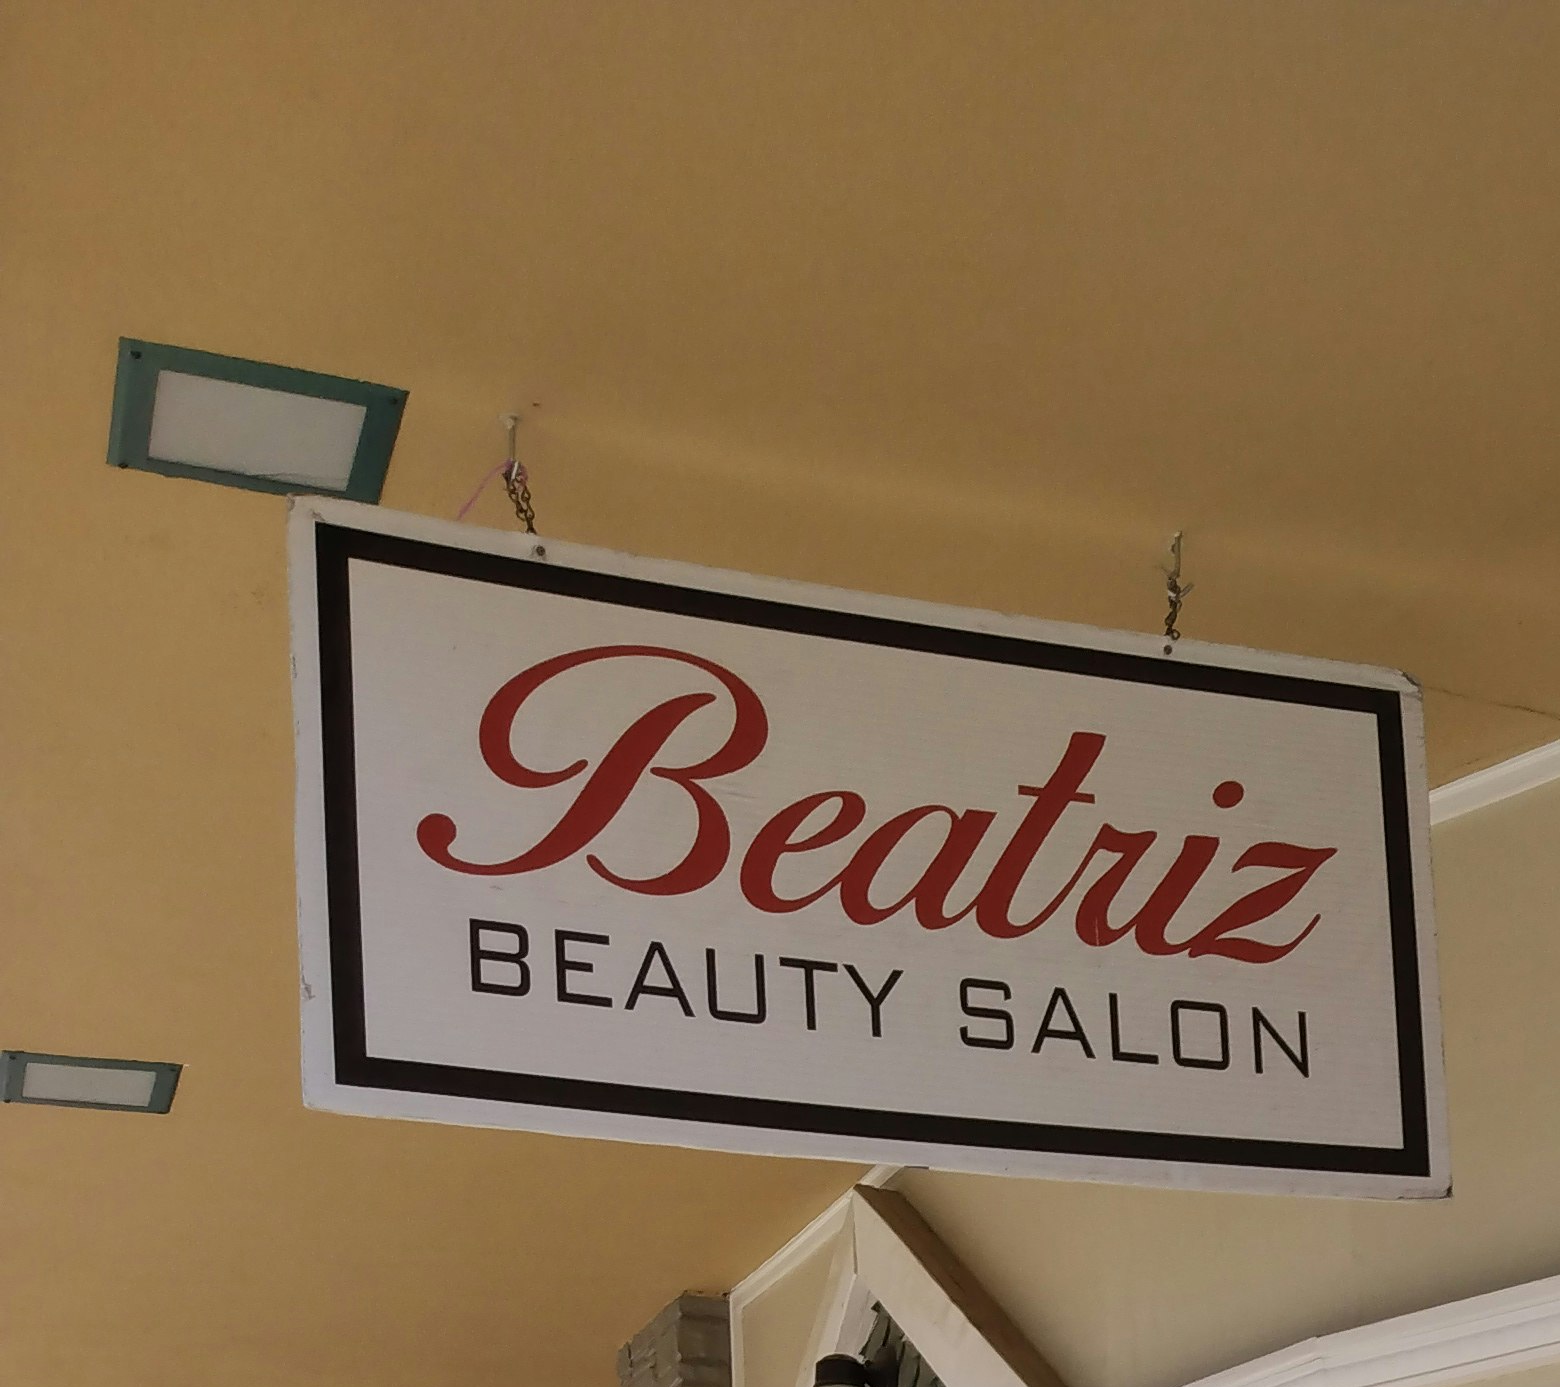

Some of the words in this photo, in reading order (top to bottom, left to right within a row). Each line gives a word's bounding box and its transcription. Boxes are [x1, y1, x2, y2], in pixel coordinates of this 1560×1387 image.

[416, 645, 1338, 964] Beatriz
[468, 918, 904, 1038] BEAUTY
[957, 979, 1311, 1078] SALON
